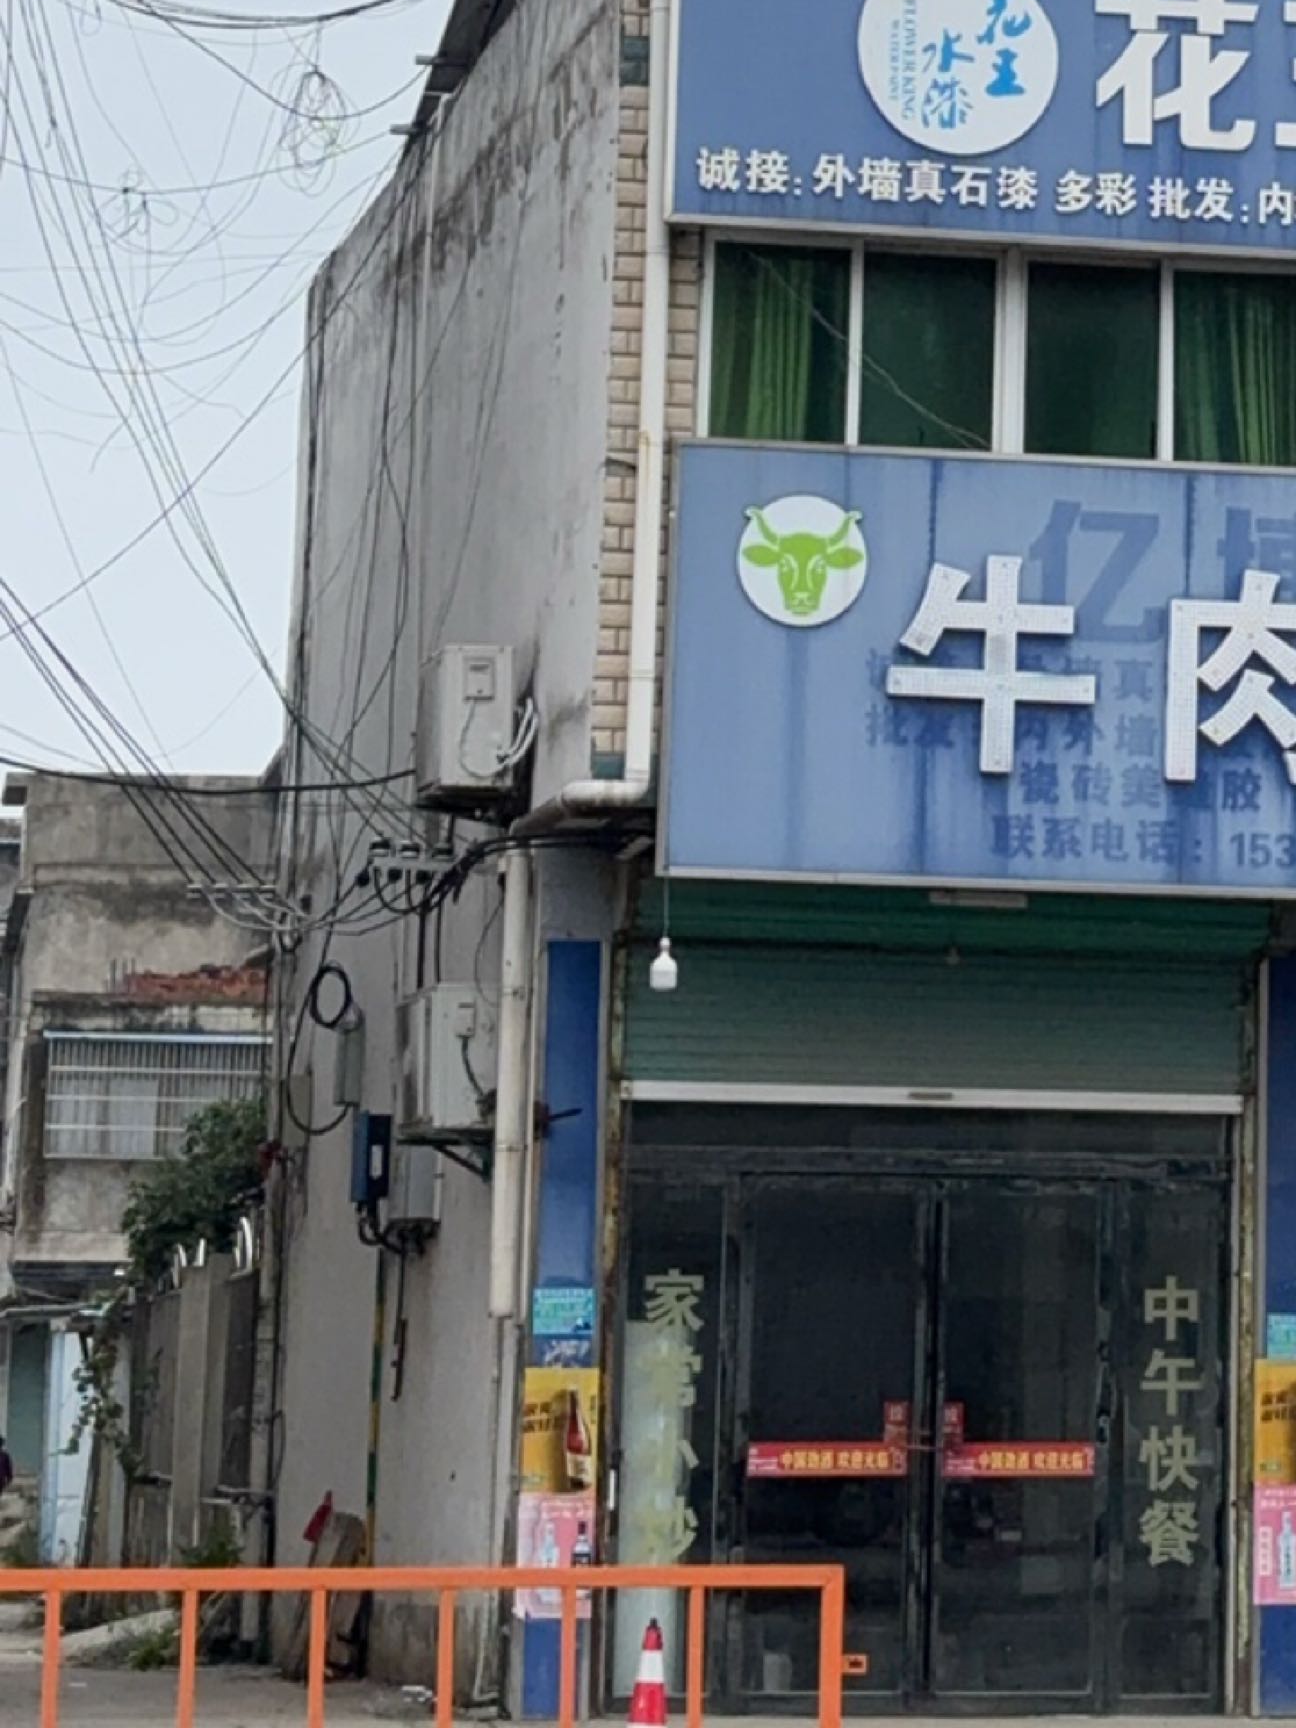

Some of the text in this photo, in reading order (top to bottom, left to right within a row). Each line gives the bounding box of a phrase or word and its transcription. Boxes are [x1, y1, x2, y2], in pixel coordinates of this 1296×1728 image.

[1055, 169, 1137, 216] 多彩
[1138, 1274, 1201, 1567] 中午快餐
